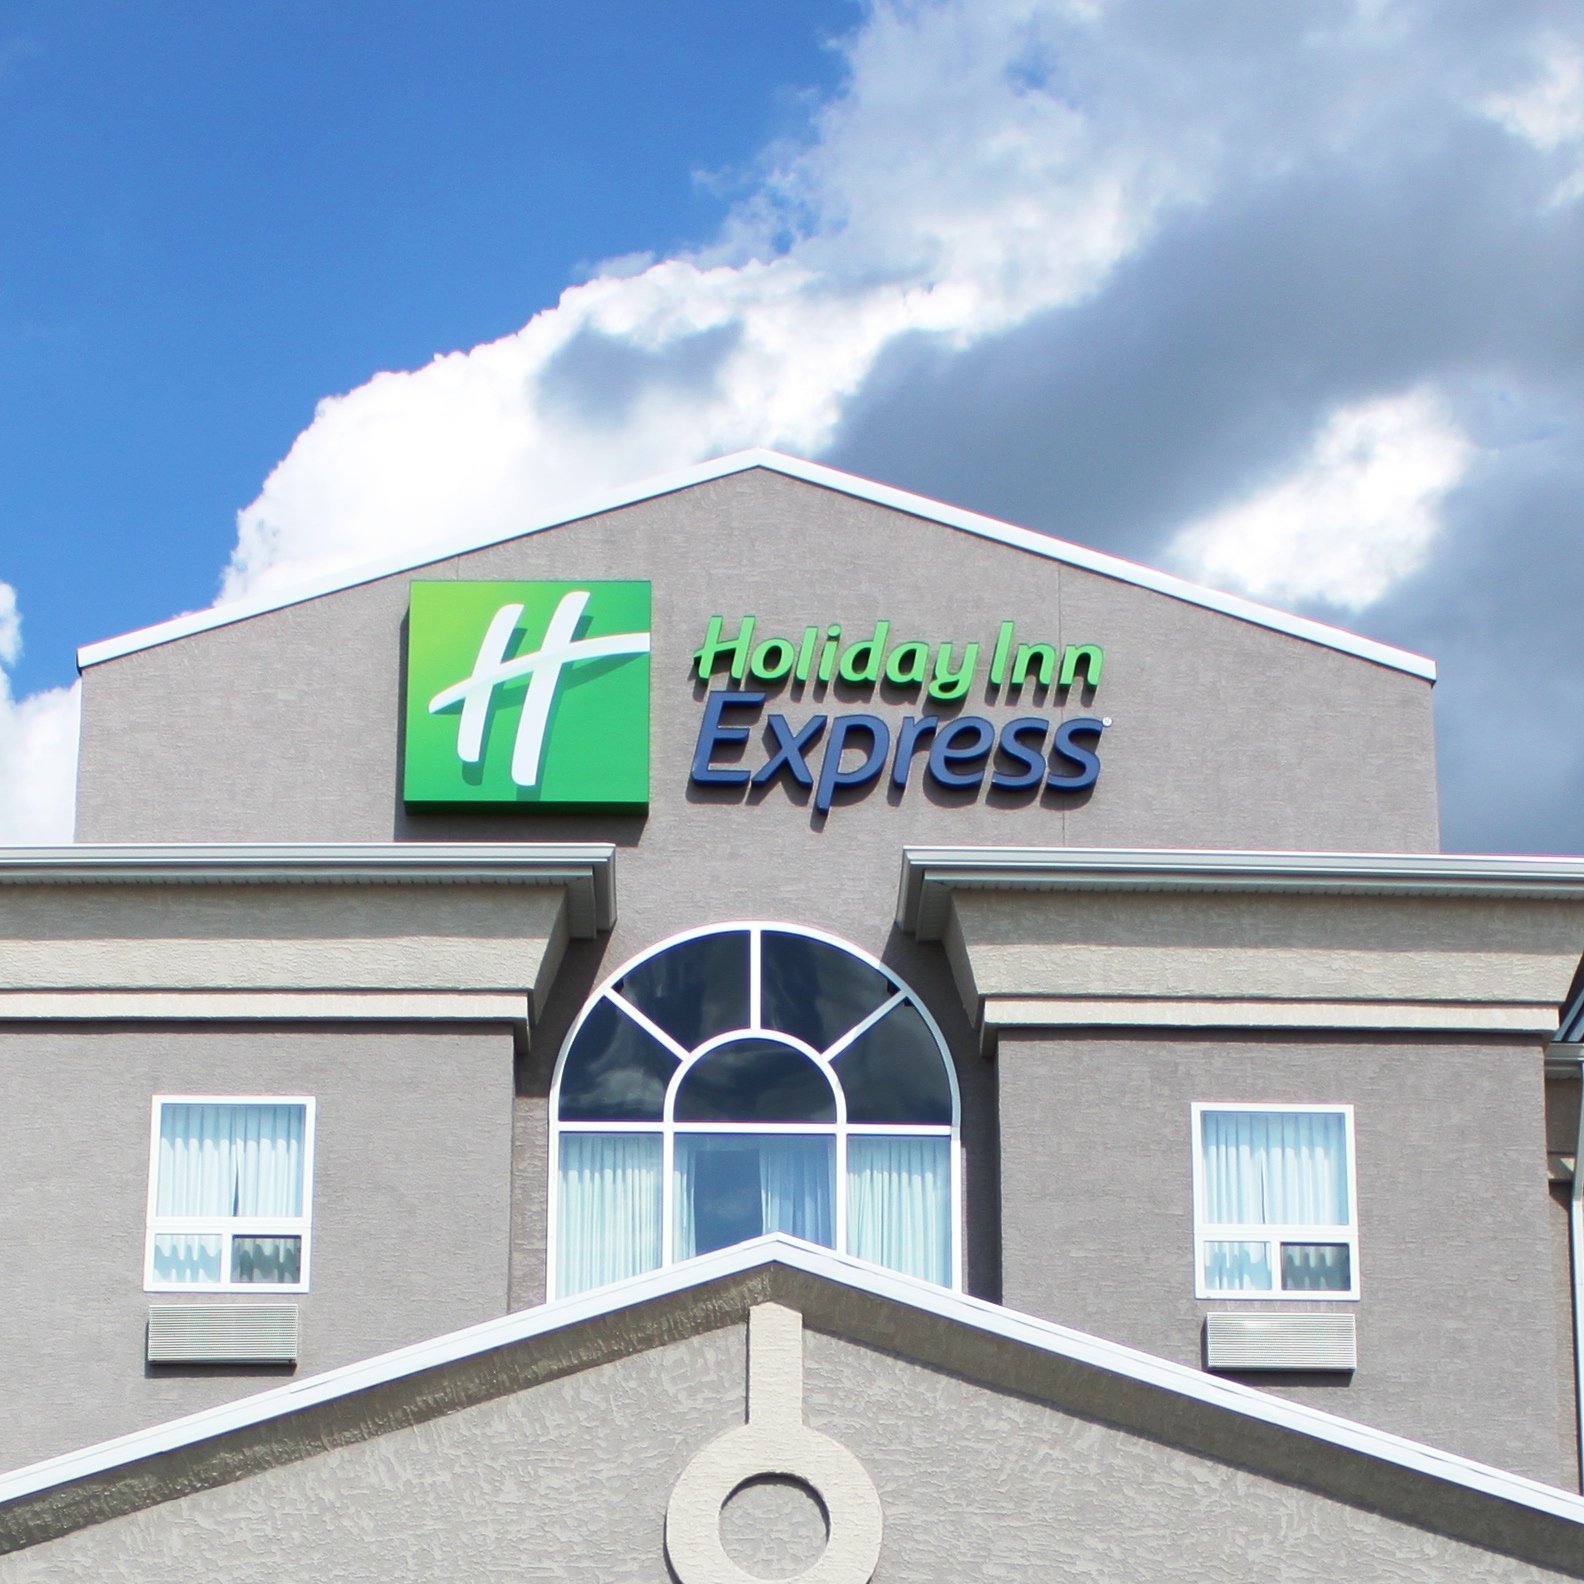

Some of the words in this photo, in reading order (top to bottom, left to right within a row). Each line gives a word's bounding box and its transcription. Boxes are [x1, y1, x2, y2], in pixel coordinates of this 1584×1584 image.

[693, 615, 979, 703] Holiday
[990, 620, 1104, 688] Inn
[691, 690, 1103, 814] Express
